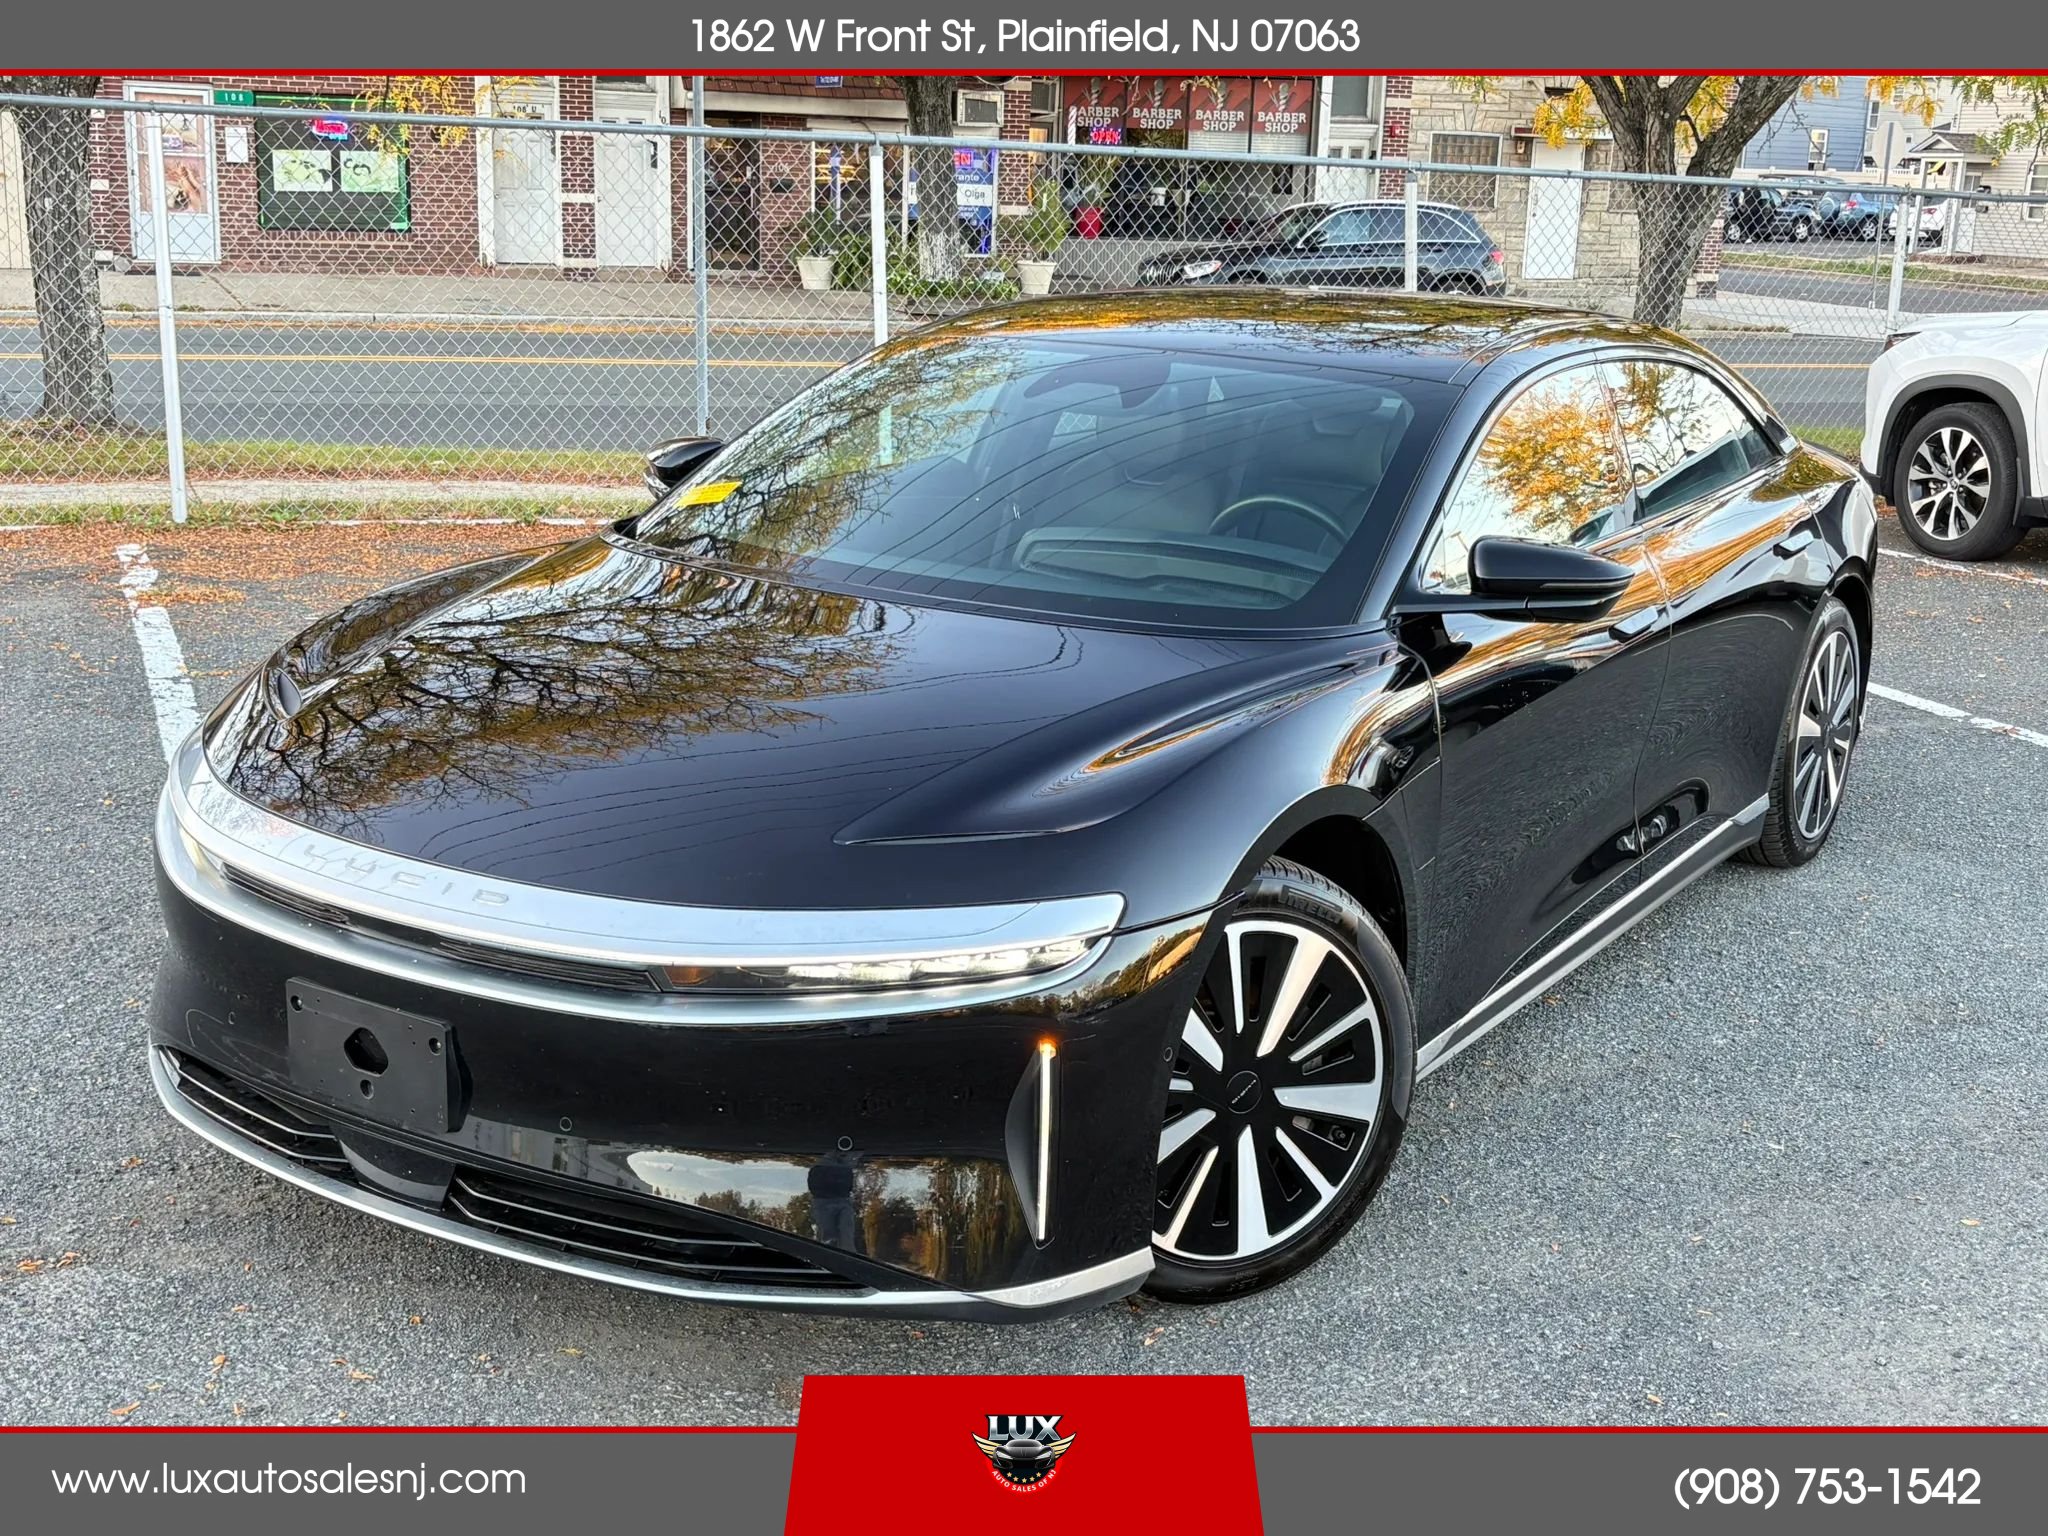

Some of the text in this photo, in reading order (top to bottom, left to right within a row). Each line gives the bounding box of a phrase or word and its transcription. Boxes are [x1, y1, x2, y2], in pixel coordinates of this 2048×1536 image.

[1077, 107, 1120, 118] ARBER
[1132, 107, 1182, 120] BARBER
[1195, 109, 1244, 121] BARBER
[1257, 111, 1307, 123] BARBER
[1077, 117, 1112, 128] SHOP
[1140, 119, 1174, 129] SHOP
[1202, 121, 1237, 132] SHOP
[1264, 122, 1299, 133] SHOP
[1092, 131, 1119, 142] OPEN
